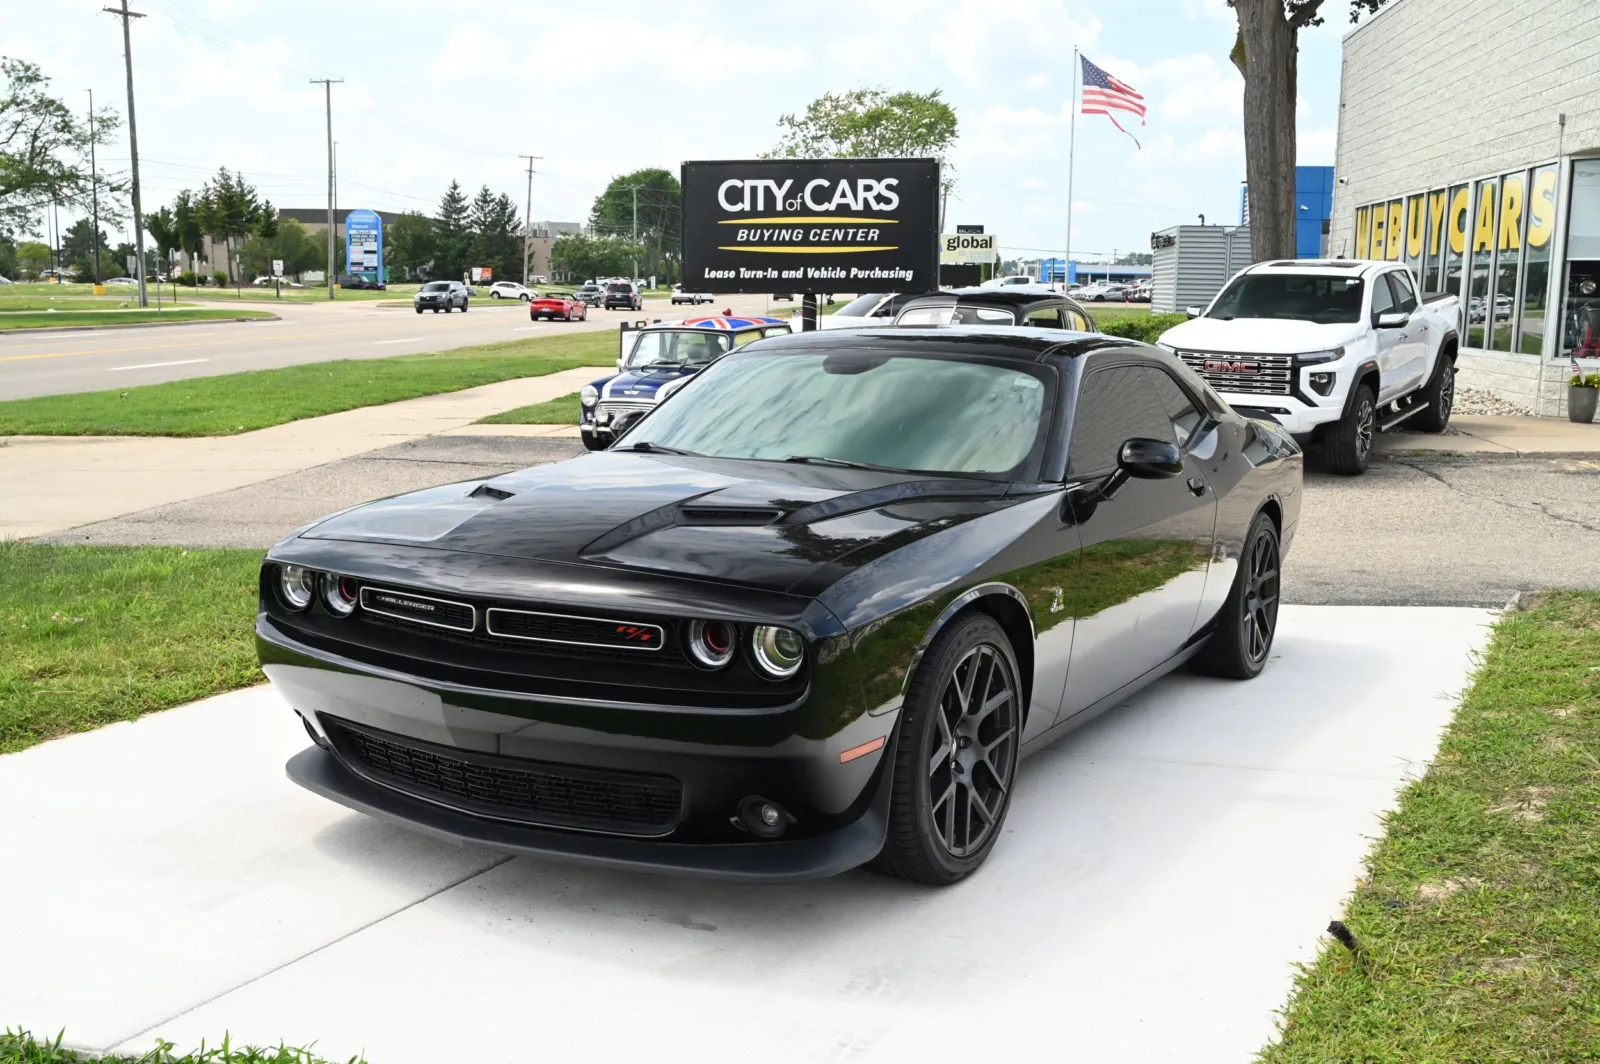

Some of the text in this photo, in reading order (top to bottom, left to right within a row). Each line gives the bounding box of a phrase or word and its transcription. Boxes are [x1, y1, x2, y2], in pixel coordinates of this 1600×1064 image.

[717, 177, 900, 212] CITY of CARS
[736, 228, 880, 242] BUYING CENTER
[947, 236, 992, 251] global
[704, 267, 914, 282] Lease Turn-In and Vehicle Purchasing
[1205, 360, 1259, 374] GMC
[376, 595, 435, 611] CHALLENGER
[616, 625, 652, 641] R/T
